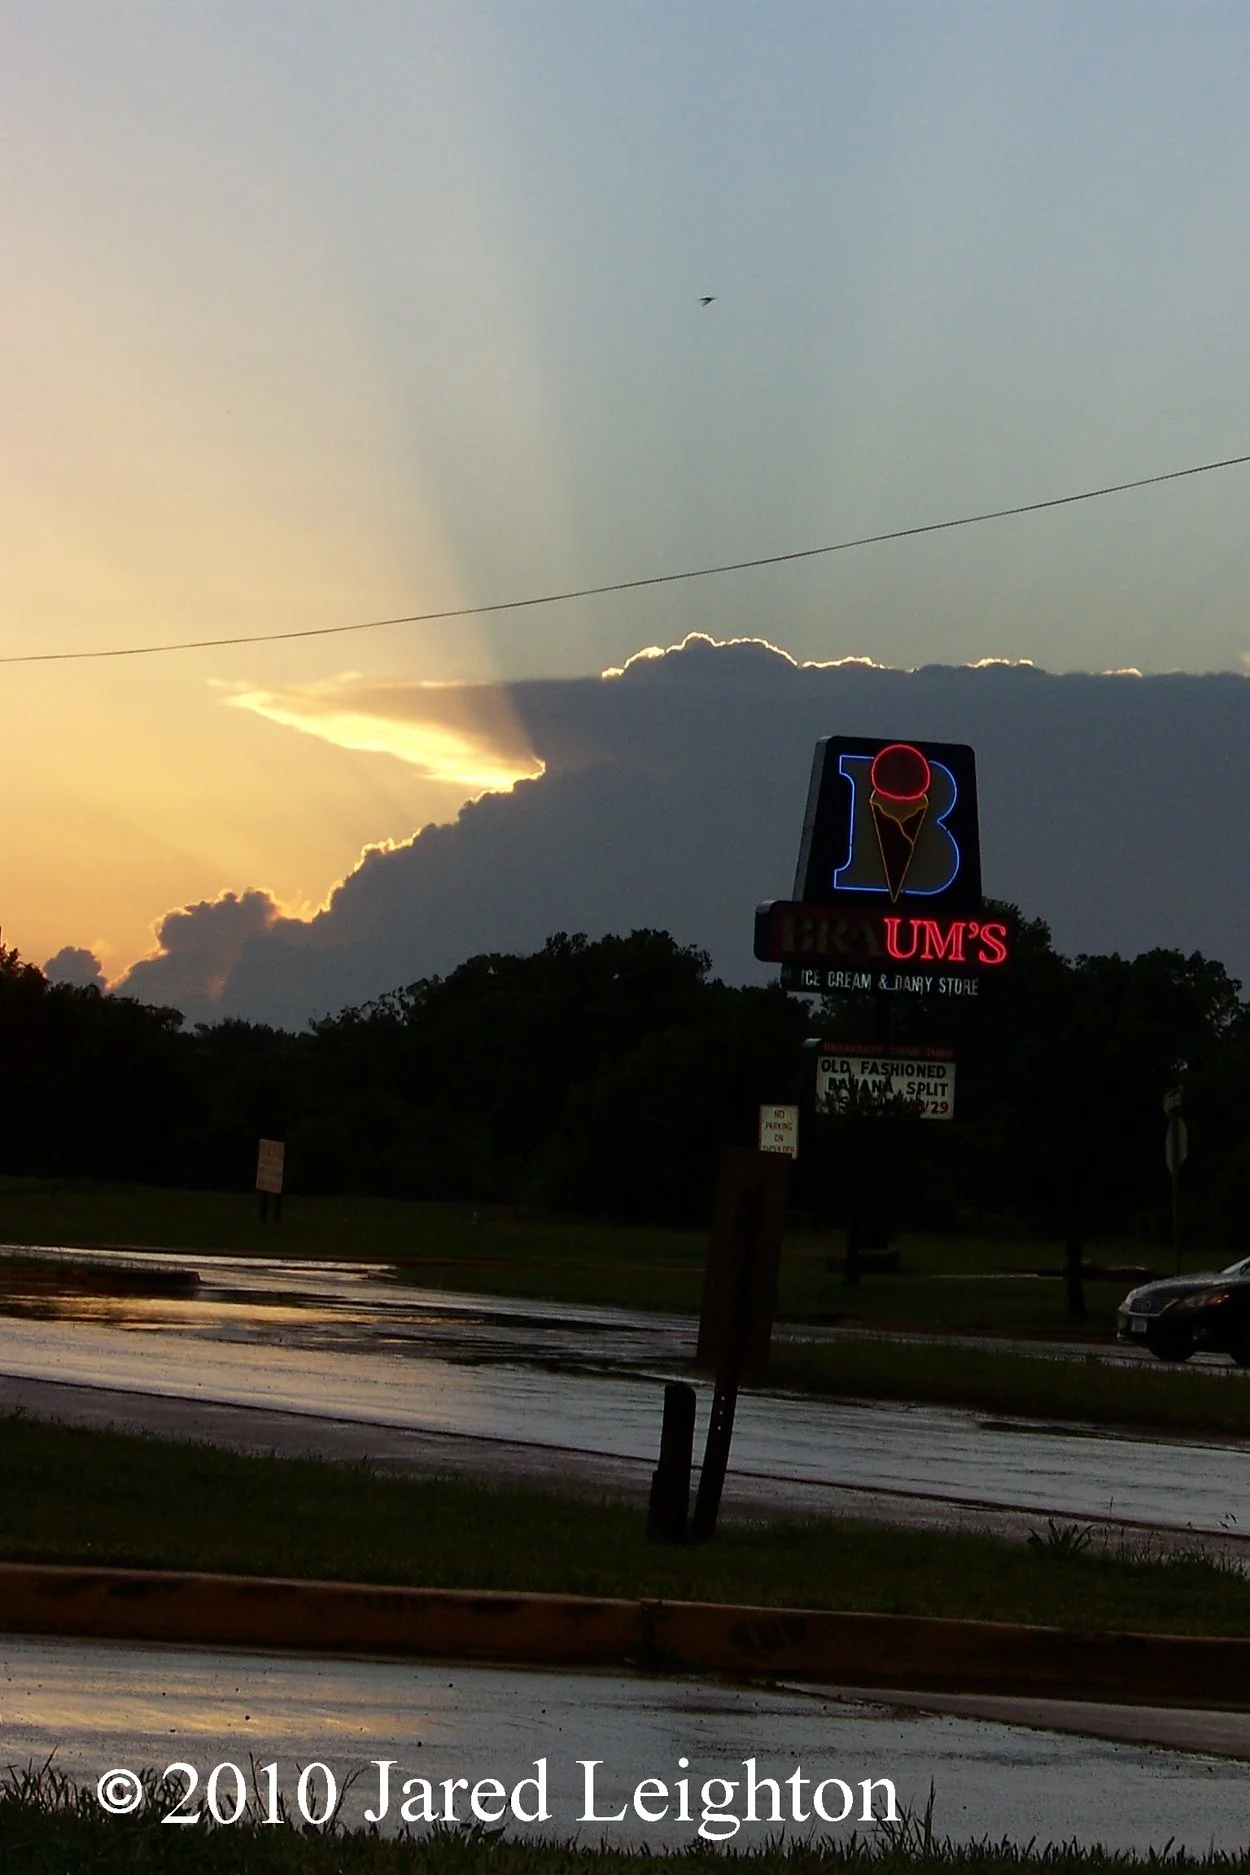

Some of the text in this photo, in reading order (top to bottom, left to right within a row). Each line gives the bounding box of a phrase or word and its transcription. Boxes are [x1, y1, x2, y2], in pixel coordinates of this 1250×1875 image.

[781, 912, 1009, 966] BRAUM'S
[800, 968, 821, 988] ICE
[827, 970, 872, 992] CREAM
[878, 974, 889, 990] &
[938, 976, 980, 997] STORE
[821, 1058, 946, 1079] OLD FASHIONED
[906, 1081, 949, 1097] SPLIT
[774, 1109, 785, 1119] NO
[765, 1121, 793, 1132] PARKING
[774, 1133, 784, 1142] ON
